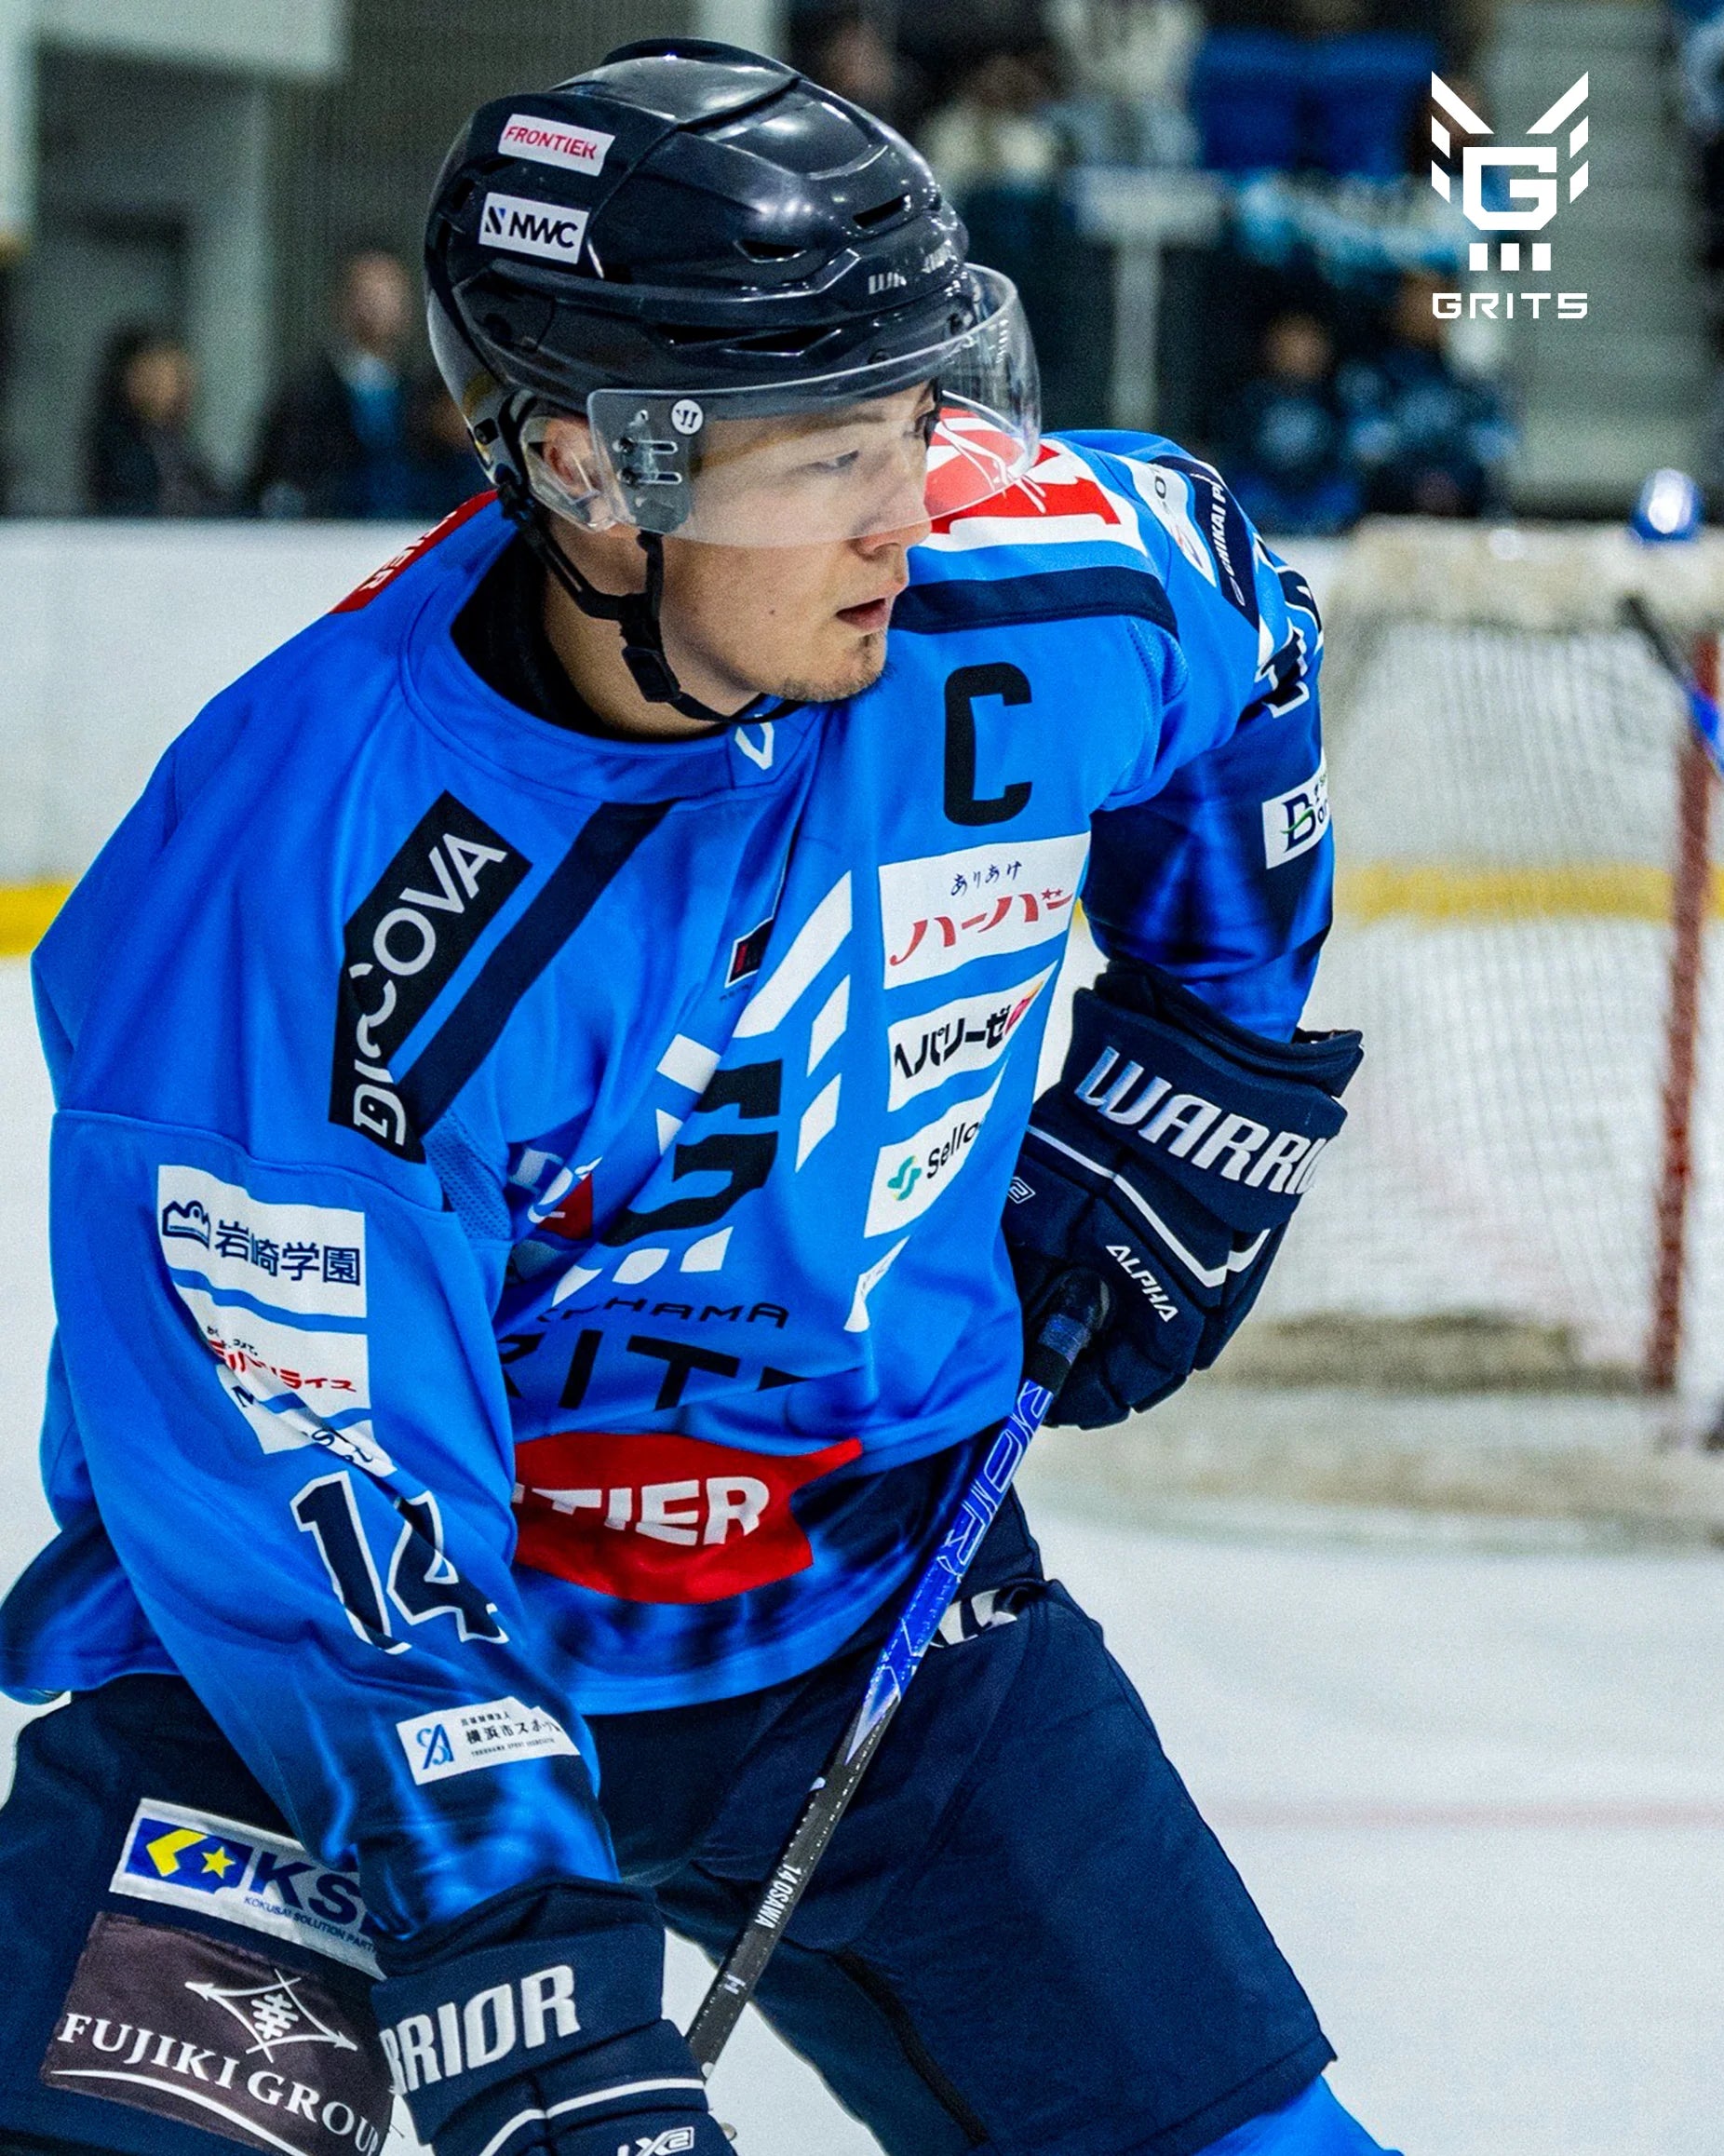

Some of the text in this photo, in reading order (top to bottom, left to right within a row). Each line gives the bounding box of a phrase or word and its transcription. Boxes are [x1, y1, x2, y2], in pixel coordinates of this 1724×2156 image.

[504, 127, 598, 160] FRONTIER
[508, 210, 579, 249] NWC
[943, 661, 1032, 827] C
[950, 860, 1023, 896] ありあけ
[894, 1004, 1012, 1079] ヘパリーゼ
[214, 1219, 361, 1287] 岩崎学園
[1105, 1245, 1179, 1323] ALPHA
[512, 1476, 770, 1546] TIER
[289, 1468, 510, 1655] 14
[754, 1863, 801, 1929] 14 OSAWA
[293, 1912, 346, 1940] SOLUTION
[346, 1931, 375, 1954] PART
[57, 2013, 379, 2156] FUJIKI GROU
